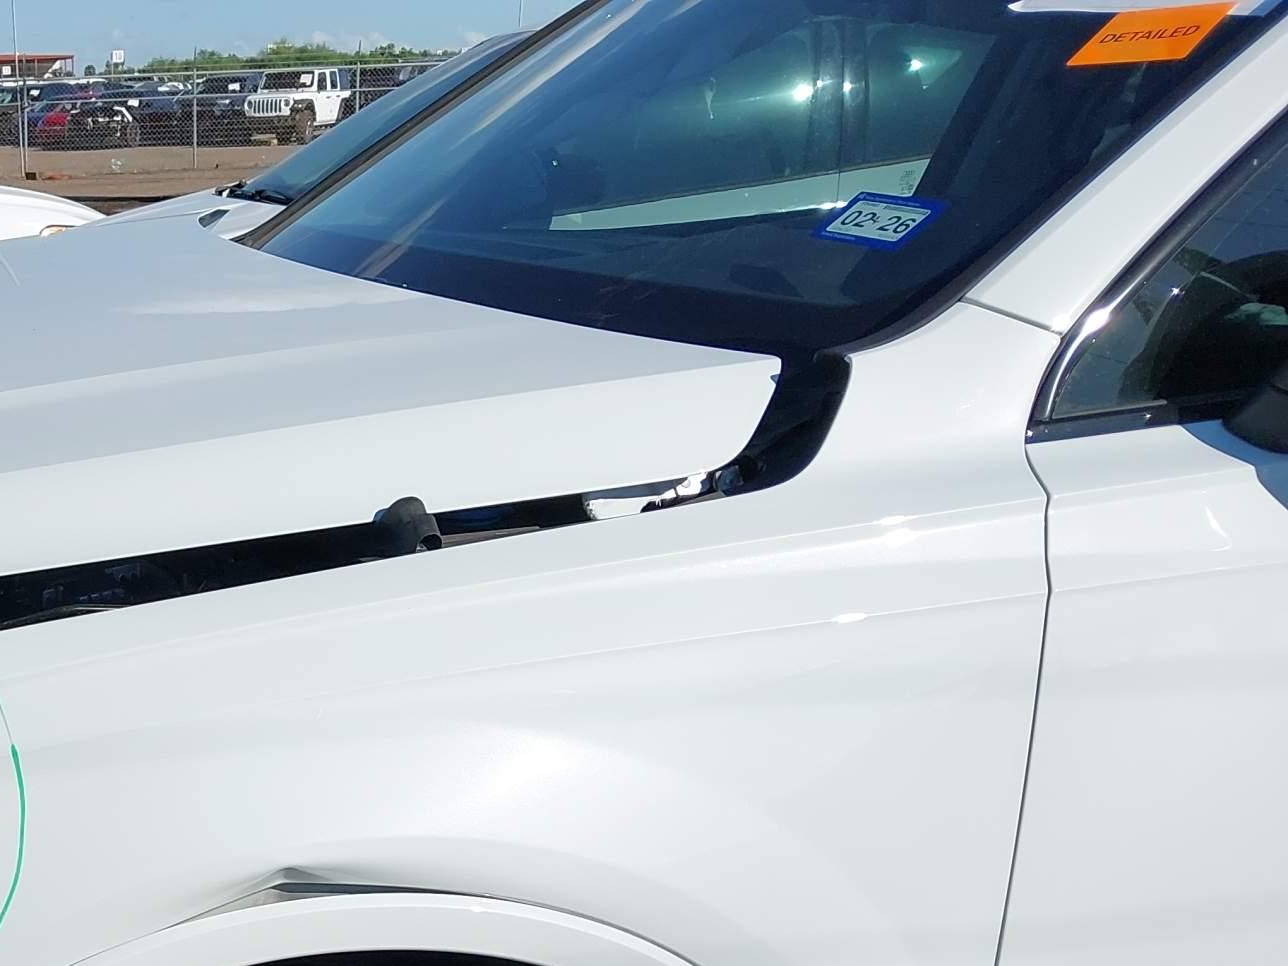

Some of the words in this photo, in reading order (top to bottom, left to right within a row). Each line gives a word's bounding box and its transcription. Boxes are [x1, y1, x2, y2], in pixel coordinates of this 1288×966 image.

[1099, 25, 1201, 44] DETAILED
[840, 210, 874, 228] 02
[876, 215, 917, 234] 26
